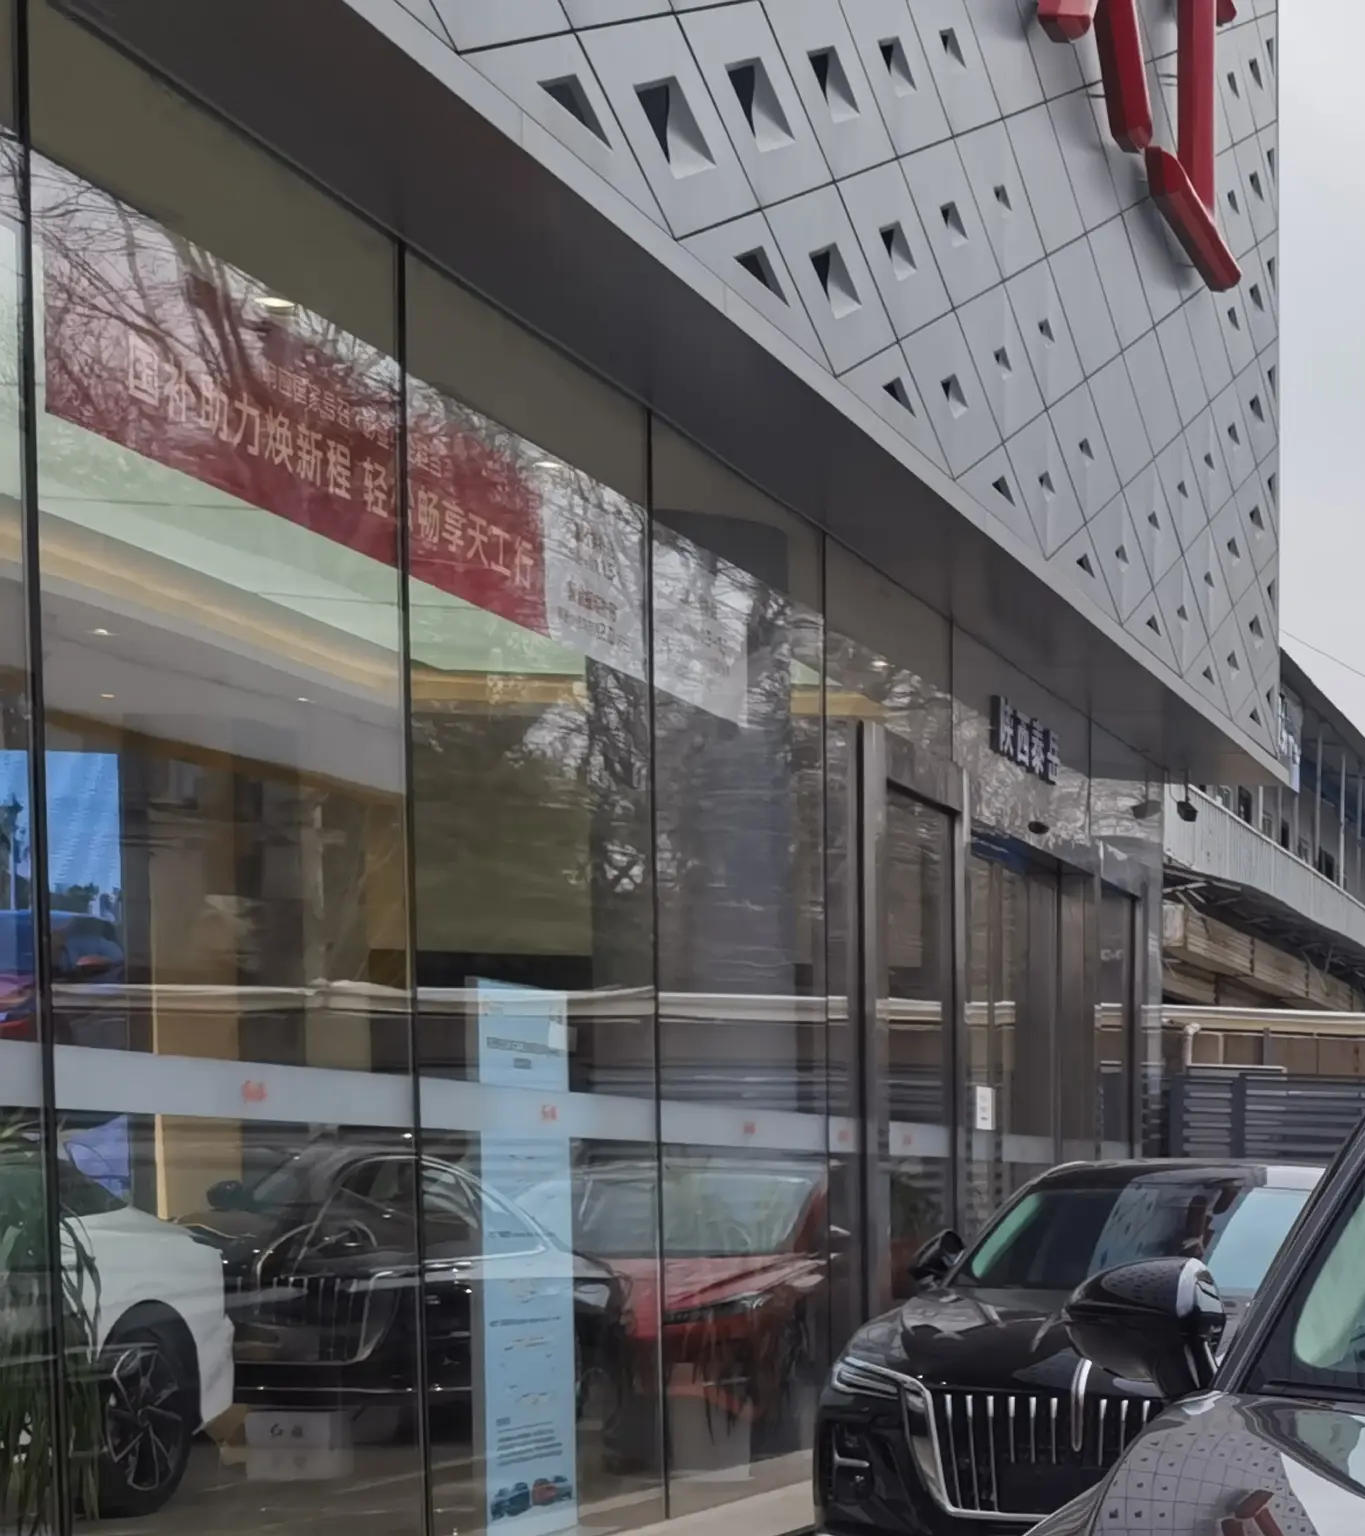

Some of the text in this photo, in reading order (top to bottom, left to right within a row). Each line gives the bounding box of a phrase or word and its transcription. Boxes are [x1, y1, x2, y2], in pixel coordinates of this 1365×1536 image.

[362, 456, 534, 590] 轻畅享天工行
